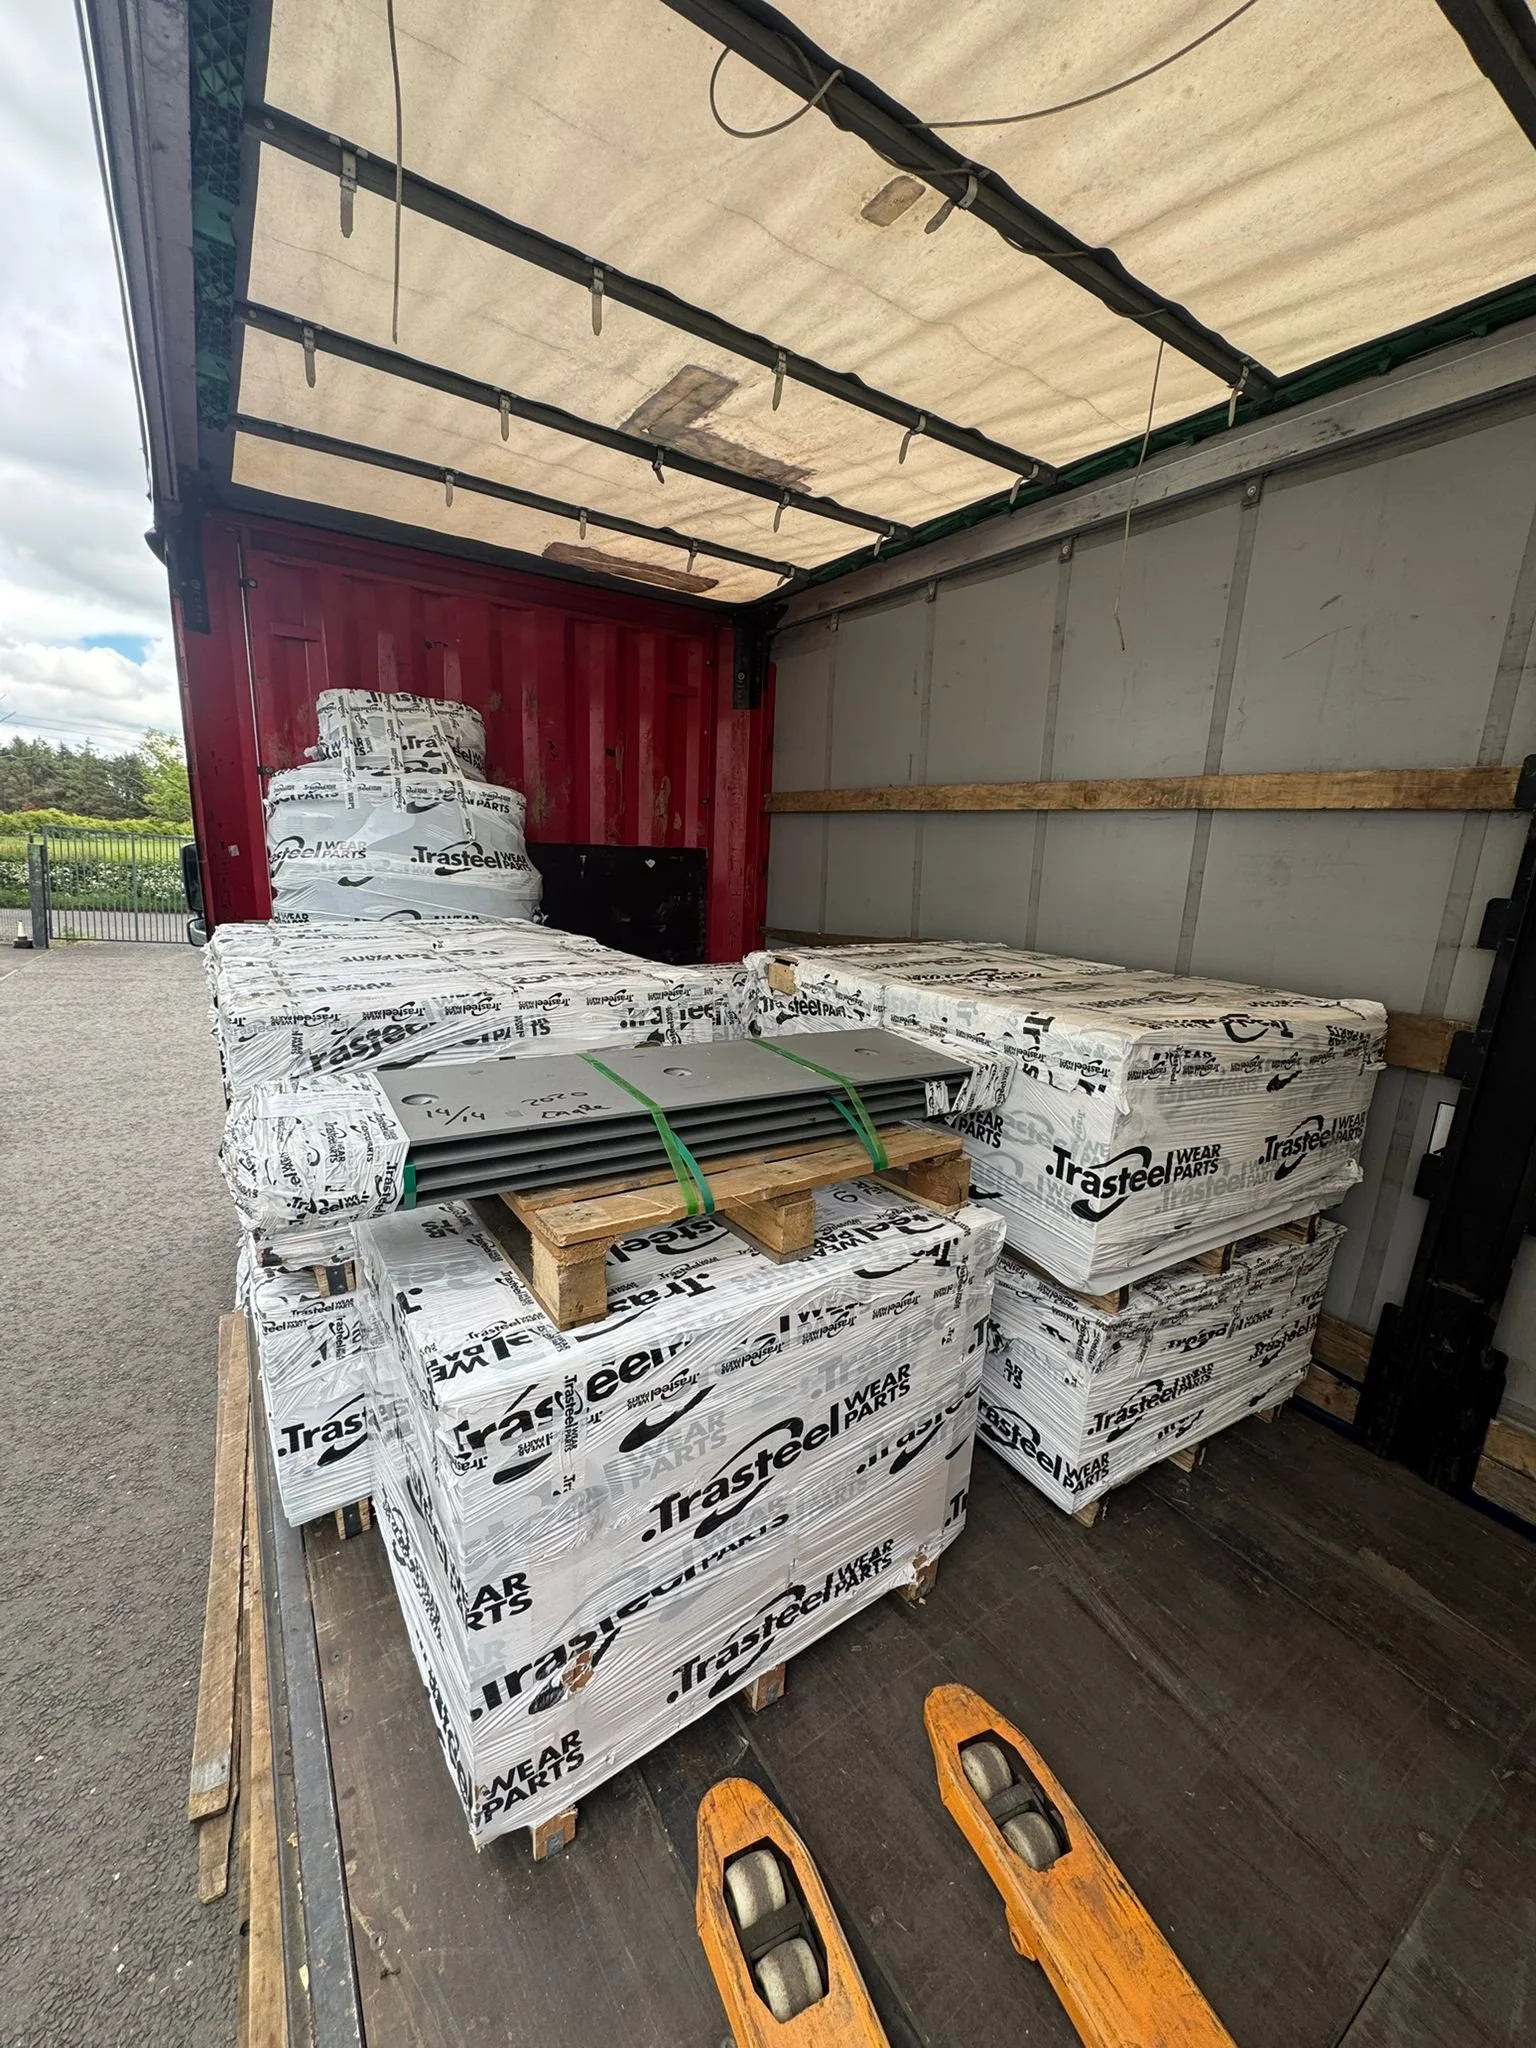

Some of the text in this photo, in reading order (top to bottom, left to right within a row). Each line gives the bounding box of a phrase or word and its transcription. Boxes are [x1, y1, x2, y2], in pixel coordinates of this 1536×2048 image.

[321, 850, 367, 859] PARTS
[521, 1091, 589, 1107] 2020
[426, 1105, 486, 1126] 14/14
[959, 1118, 1002, 1149] PARTS
[1174, 1144, 1221, 1165] WEAR
[1173, 1159, 1219, 1182] PARTS
[821, 1316, 857, 1339] .Trasteel
[743, 1341, 785, 1366] .Trasteel
[564, 1374, 578, 1429] .Trasteel
[651, 1371, 700, 1403] .Trasteel
[843, 1363, 911, 1411] WEAR
[844, 1379, 911, 1429] PARTS
[517, 1435, 545, 1451] PARTS
[518, 1440, 546, 1457] WEAR
[642, 1402, 840, 1542] .Trasteel
[1063, 1464, 1110, 1495] PARTS
[1065, 1452, 1110, 1482] WEAR
[835, 1553, 893, 1598] PARTS
[838, 1538, 895, 1582] WEAR
[666, 1570, 834, 1704] .Trasteel
[485, 1728, 584, 1799] WEAR
[478, 1749, 585, 1827] PARTS
